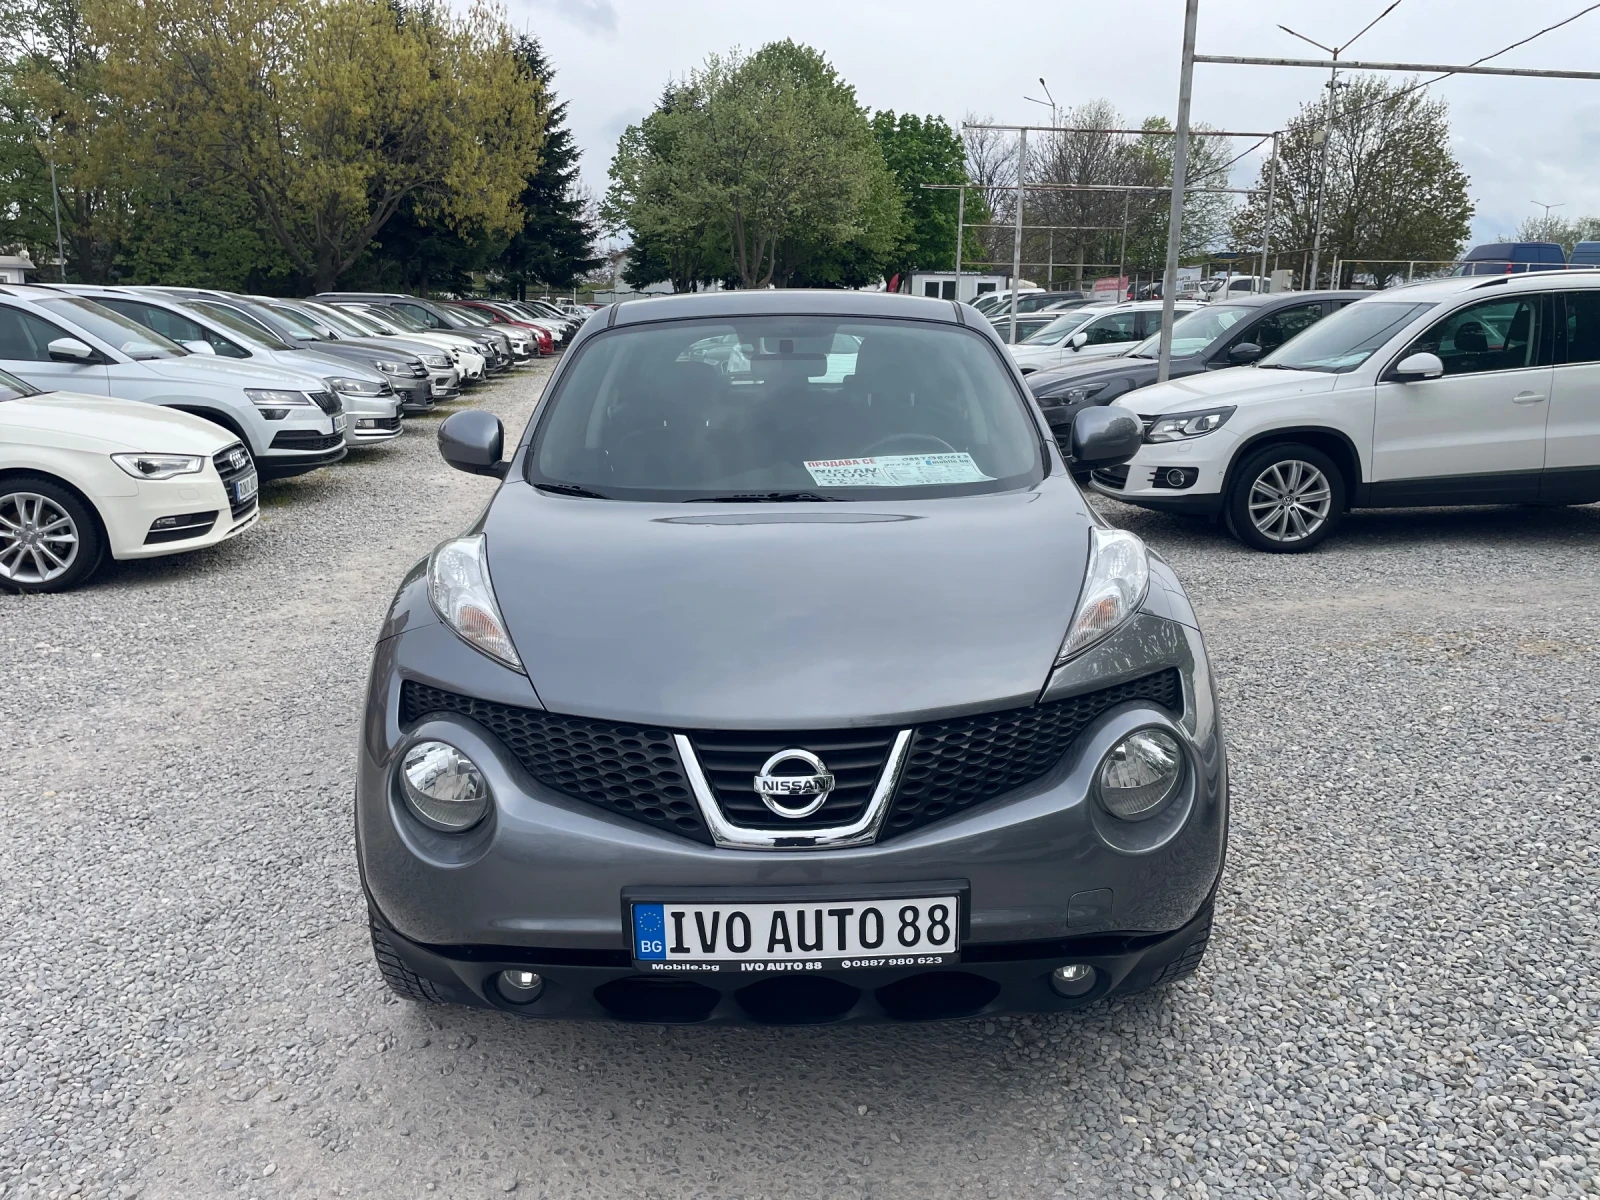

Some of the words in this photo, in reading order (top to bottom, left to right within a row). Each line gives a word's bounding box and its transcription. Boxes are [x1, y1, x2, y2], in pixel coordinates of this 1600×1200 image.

[807, 459, 860, 468] ПРОДАВА
[762, 780, 825, 791] NISSAN
[669, 910, 752, 954] IVO
[767, 907, 885, 953] AUTO
[897, 903, 951, 948] 88
[641, 940, 663, 954] BG
[741, 962, 764, 971] IVO
[766, 962, 803, 971] AUTO
[805, 961, 823, 970] 88
[852, 959, 886, 967] 0887
[889, 957, 914, 966] 980
[917, 956, 943, 964] 623
[651, 963, 720, 972] Mobile.bg
